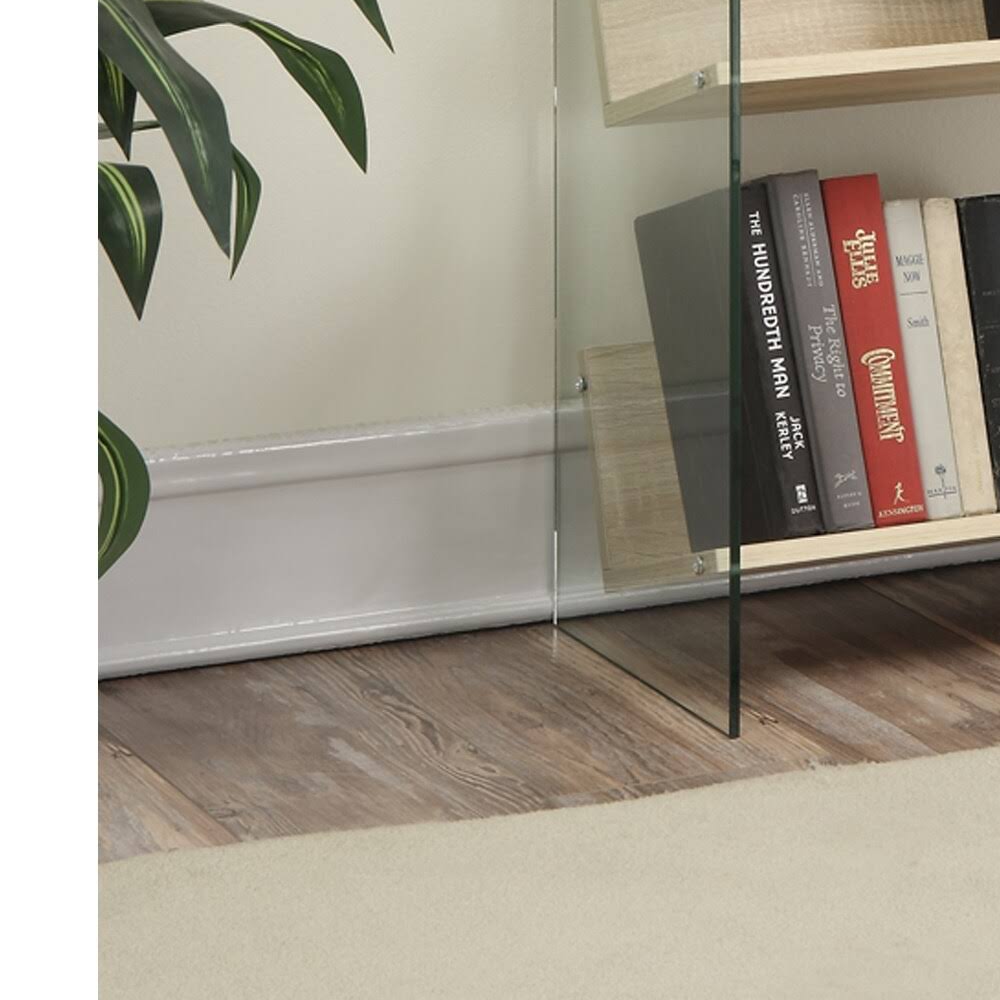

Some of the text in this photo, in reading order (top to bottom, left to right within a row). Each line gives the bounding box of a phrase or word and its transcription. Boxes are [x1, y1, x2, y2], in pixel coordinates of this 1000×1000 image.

[748, 210, 792, 400] THE HUNDREDTH MAN
[906, 316, 930, 329] Smith
[808, 324, 827, 382] Privacy
[823, 304, 846, 398] The Right to
[860, 348, 905, 444] COMMITMENT
[775, 411, 794, 460] KERLEY
[789, 415, 805, 450] JACK
